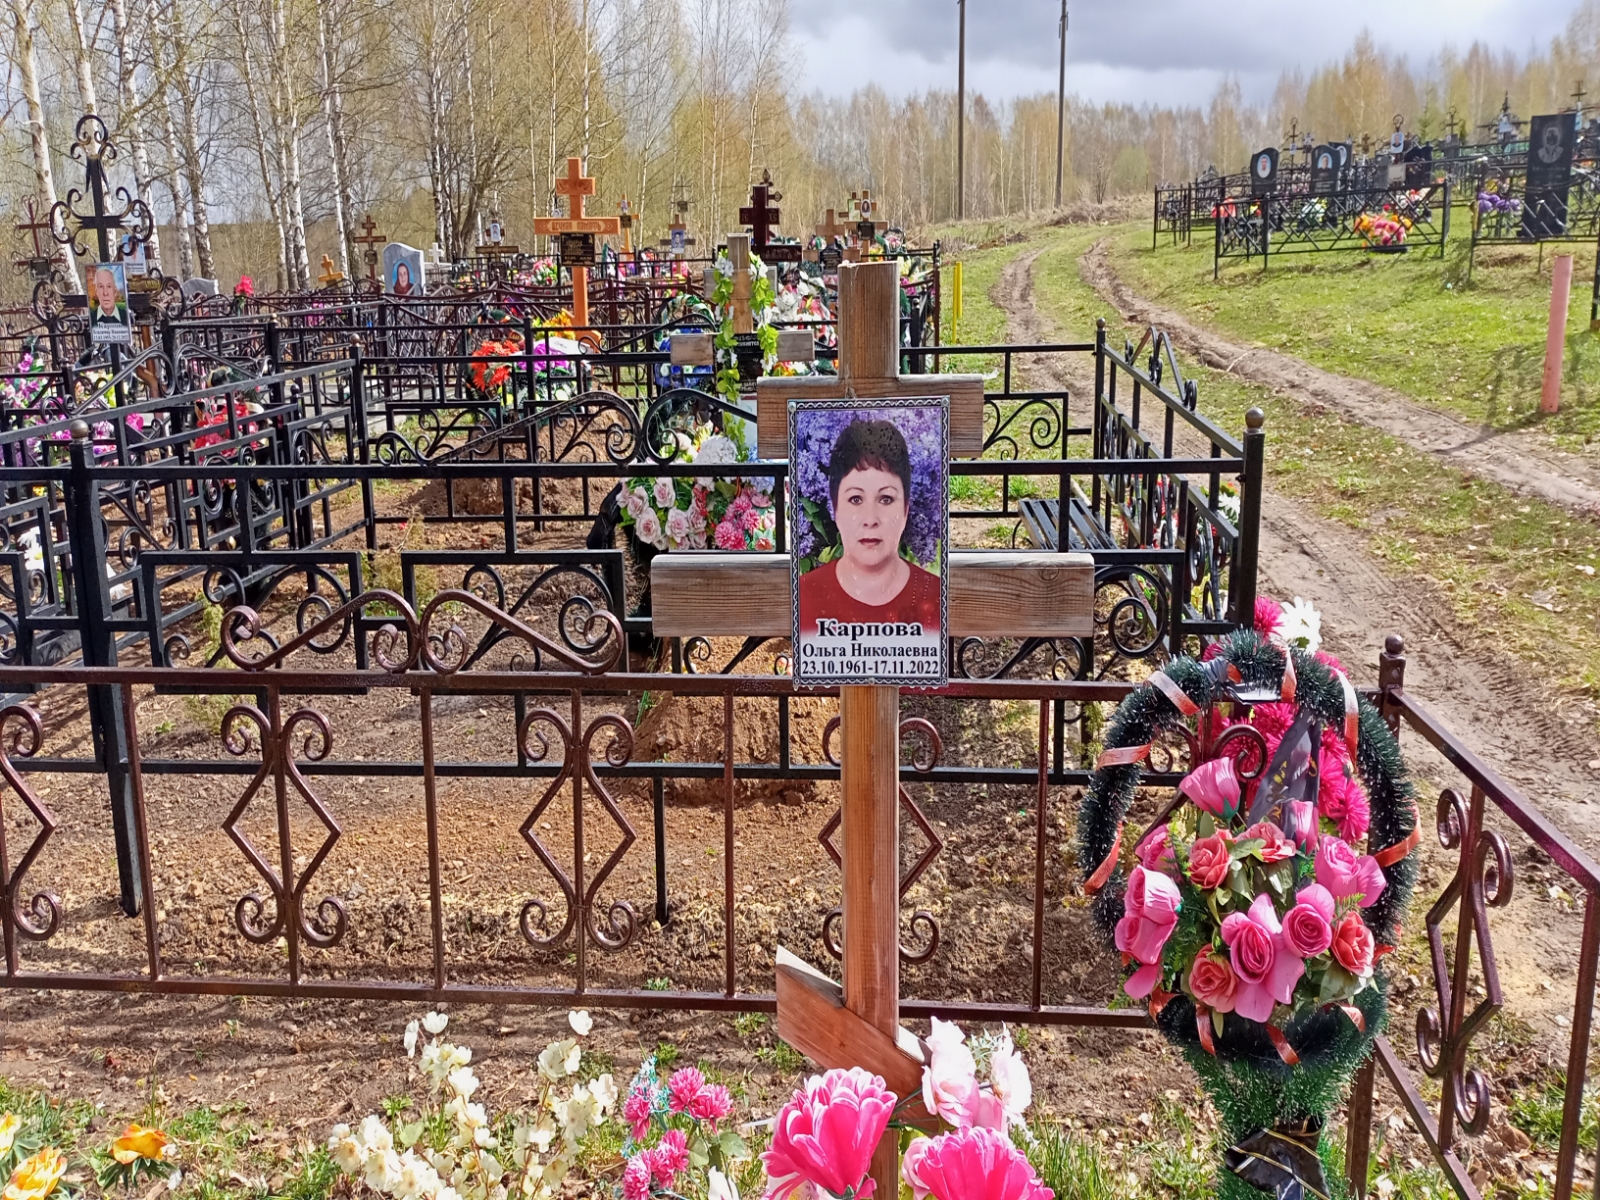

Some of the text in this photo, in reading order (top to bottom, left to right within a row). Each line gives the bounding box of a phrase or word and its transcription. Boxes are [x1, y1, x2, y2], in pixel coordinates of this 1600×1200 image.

[817, 619, 923, 641] Карпова
[802, 642, 938, 658] Ольга Николаевна
[802, 660, 939, 675] 23.10.1961-17.11.2022
